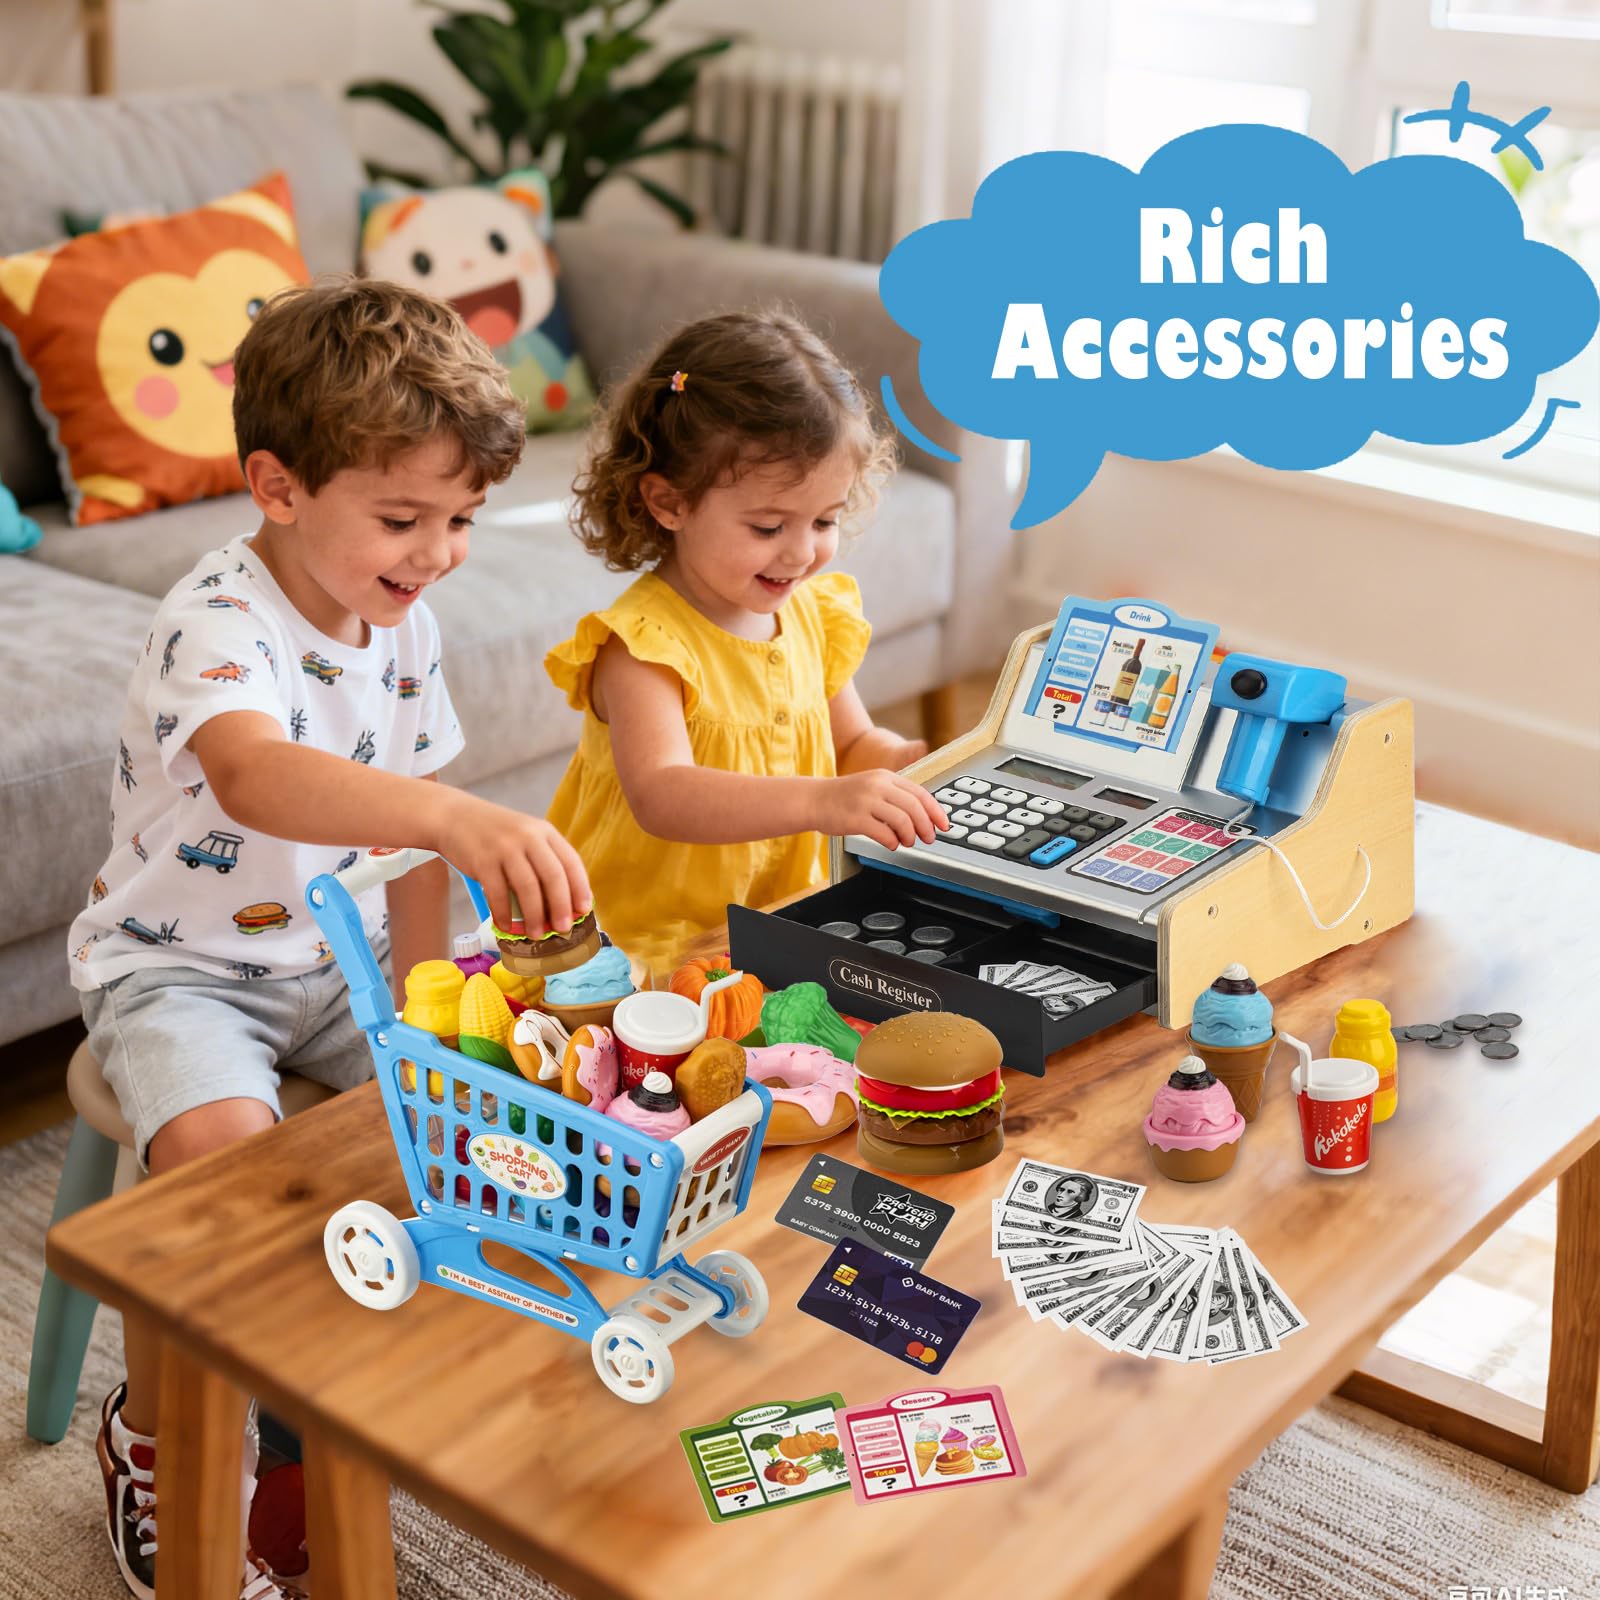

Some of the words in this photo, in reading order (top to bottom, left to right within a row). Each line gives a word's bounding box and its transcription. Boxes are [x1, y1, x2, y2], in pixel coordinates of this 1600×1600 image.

[1130, 611, 1152, 622] Drink
[1052, 690, 1073, 702] Total
[839, 966, 873, 990] Cash
[877, 979, 933, 1010] Register
[489, 1151, 549, 1181] SHOPPING
[506, 1164, 532, 1180] CART
[803, 1195, 832, 1211] 5375
[833, 1207, 861, 1223] 3900
[863, 1219, 891, 1235] 0000
[892, 1231, 921, 1248] 5823
[875, 1202, 929, 1228] PLAY
[1107, 1215, 1121, 1224] 10
[790, 1217, 809, 1228] BABY
[808, 1224, 839, 1240] COMPANY
[468, 1279, 486, 1291] BEST
[487, 1287, 521, 1304] ASSITANT
[522, 1299, 534, 1308] OF
[534, 1304, 565, 1321] MOTHER
[915, 1283, 939, 1298] BABY
[939, 1294, 963, 1310] BANK
[901, 1396, 936, 1406] Dessert
[737, 1408, 784, 1424] Vegetables
[874, 1467, 897, 1477] Total
[724, 1484, 748, 1495] Total
